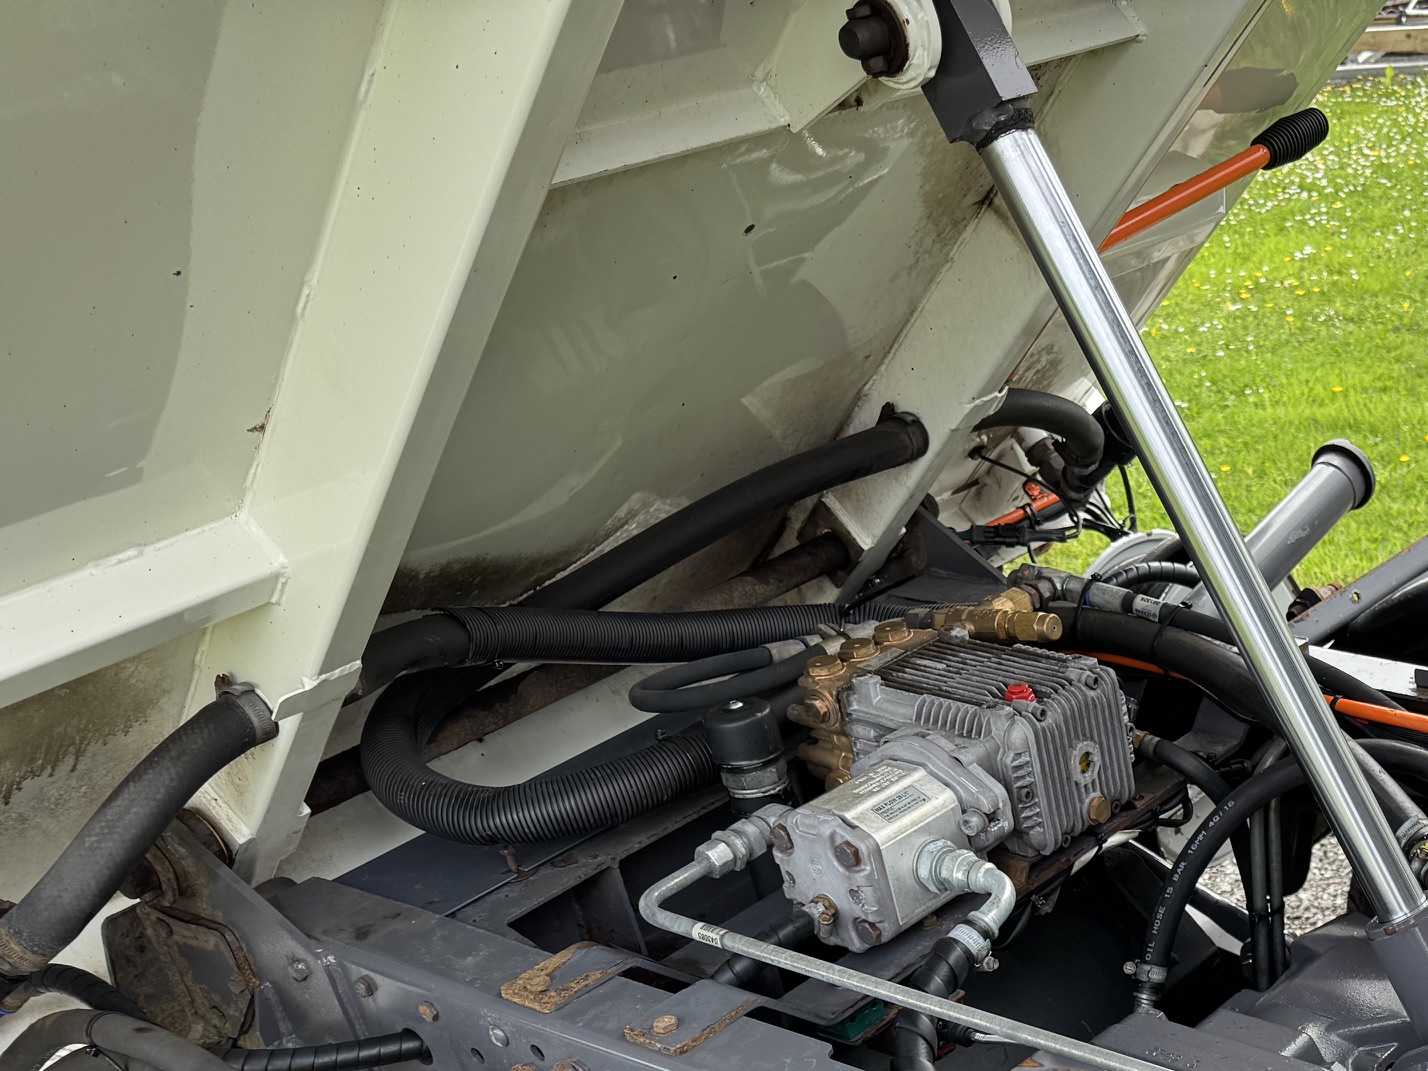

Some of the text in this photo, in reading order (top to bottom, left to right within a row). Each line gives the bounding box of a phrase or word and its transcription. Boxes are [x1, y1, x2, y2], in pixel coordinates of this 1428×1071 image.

[1145, 940, 1155, 961] OIL
[1152, 905, 1166, 934] HOSE
[1164, 886, 1174, 898] 15
[1172, 861, 1187, 882] BAR
[1187, 830, 1207, 855] 16MM
